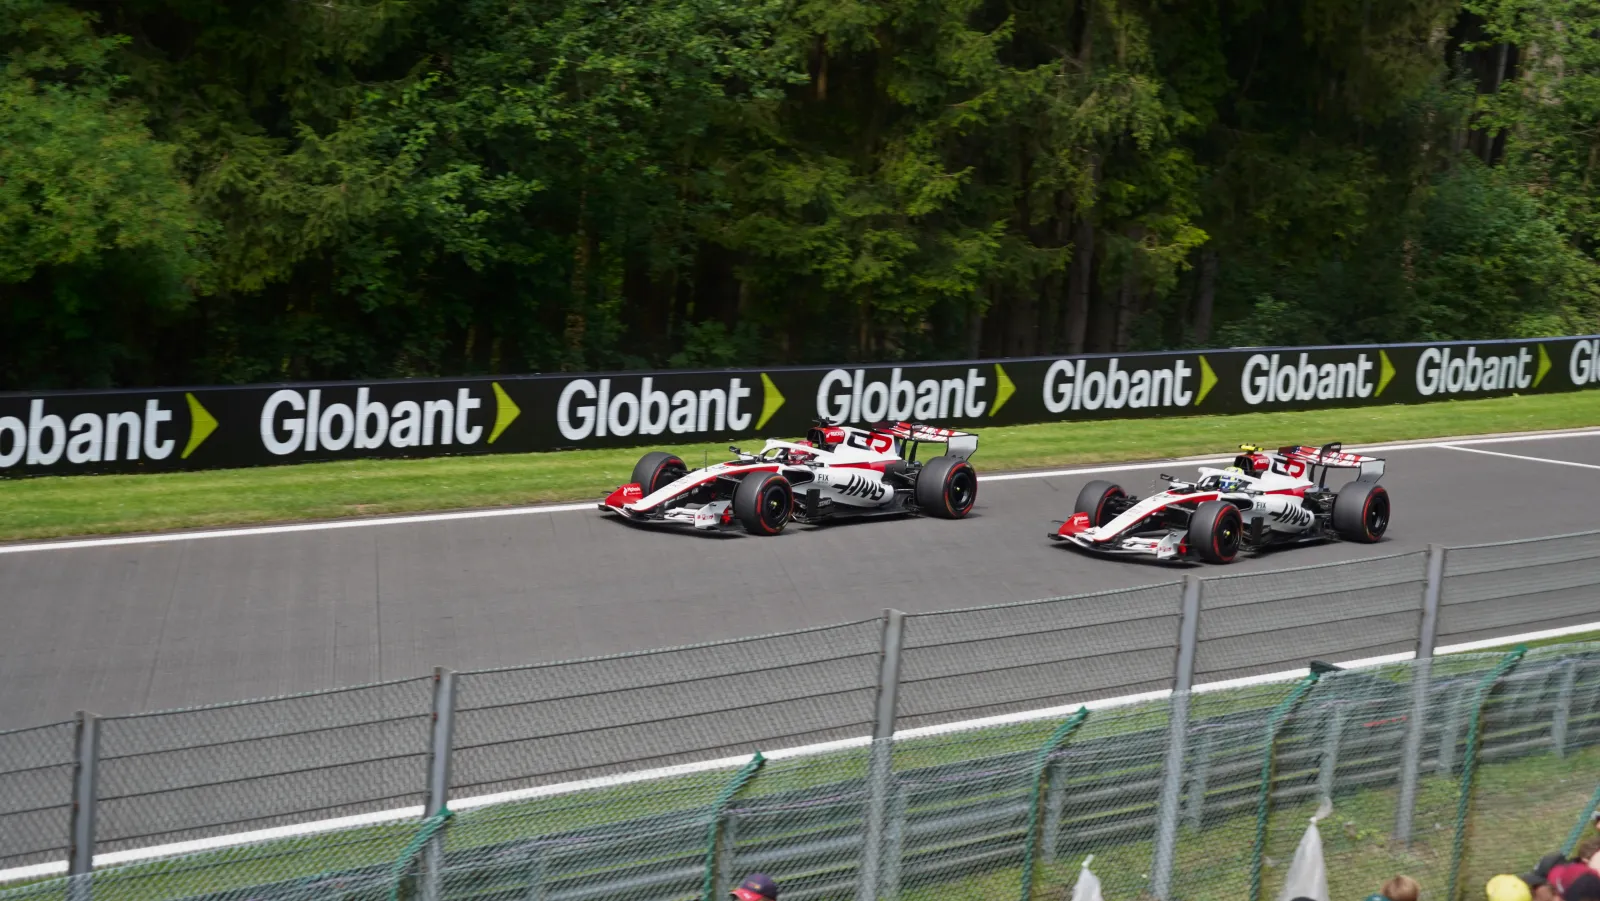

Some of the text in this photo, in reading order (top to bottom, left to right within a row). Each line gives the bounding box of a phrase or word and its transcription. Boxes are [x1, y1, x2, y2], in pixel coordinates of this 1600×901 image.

[1043, 358, 1193, 414] Globant
[1241, 352, 1373, 405] Globant
[1415, 346, 1533, 396] Globant
[1569, 339, 1600, 386] Gl
[260, 387, 483, 456] Globant
[556, 377, 755, 440] Globant
[816, 367, 987, 427] Globant
[818, 473, 829, 481] FIX
[831, 473, 886, 501] HAAS
[1256, 501, 1266, 509] FIX
[1268, 501, 1311, 527] HAAS
